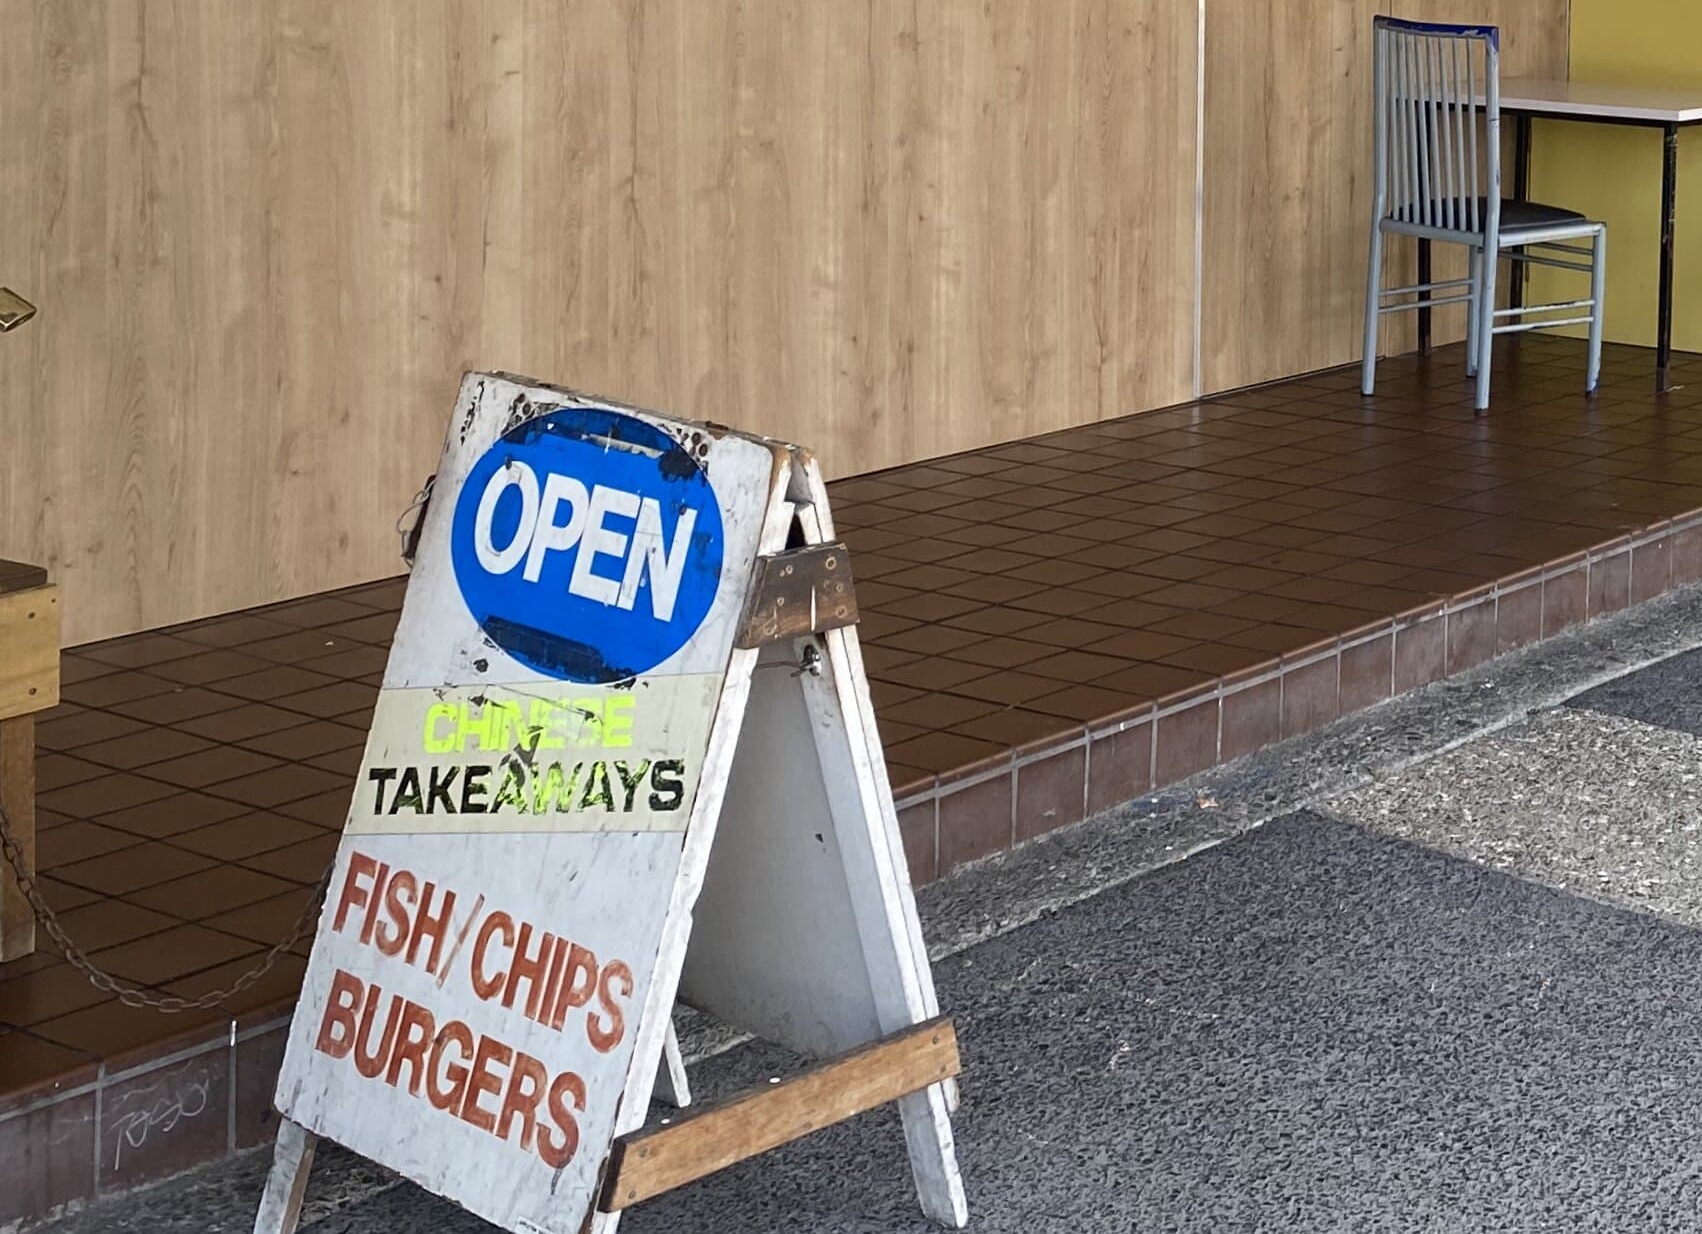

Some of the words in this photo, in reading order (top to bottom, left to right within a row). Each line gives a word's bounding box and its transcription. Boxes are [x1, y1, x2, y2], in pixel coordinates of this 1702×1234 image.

[473, 459, 700, 625] OPEN
[422, 691, 635, 755] CHINESE
[367, 757, 686, 818] TAKEAWAYS
[313, 965, 587, 1170] BURGERS
